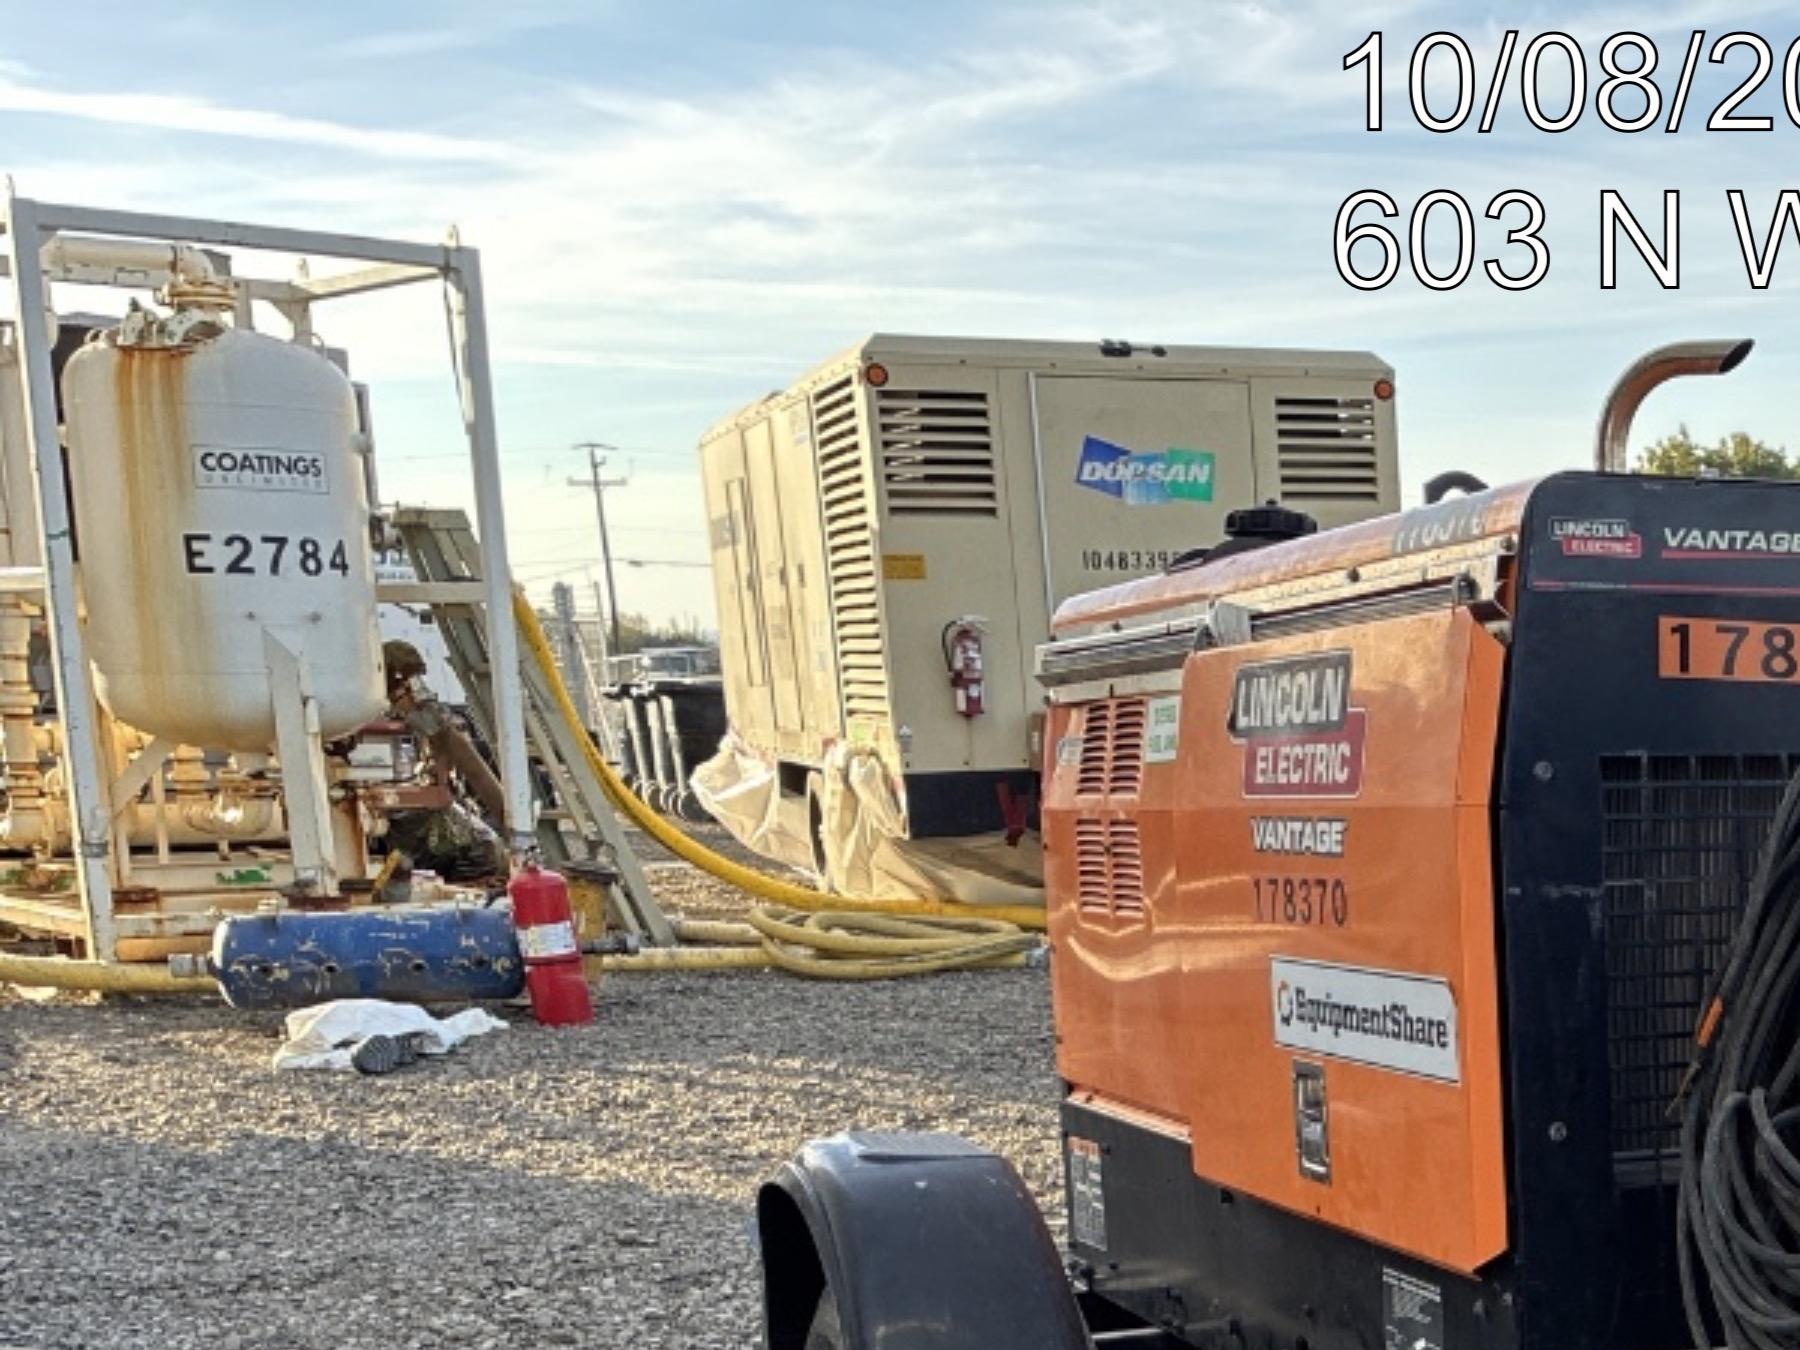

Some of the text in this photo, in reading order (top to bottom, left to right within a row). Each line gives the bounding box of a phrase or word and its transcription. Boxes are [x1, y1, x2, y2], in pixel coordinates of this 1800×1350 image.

[200, 452, 322, 478] COATINGS
[1553, 521, 1625, 538] LINCOLN
[182, 532, 350, 578] E2784
[1236, 665, 1345, 730] LINCOLN
[1254, 741, 1351, 785] ELECTRIC
[1251, 819, 1346, 855] VANTAGE
[1253, 877, 1349, 927] 178370
[1294, 987, 1449, 1049] EquipmentShare
